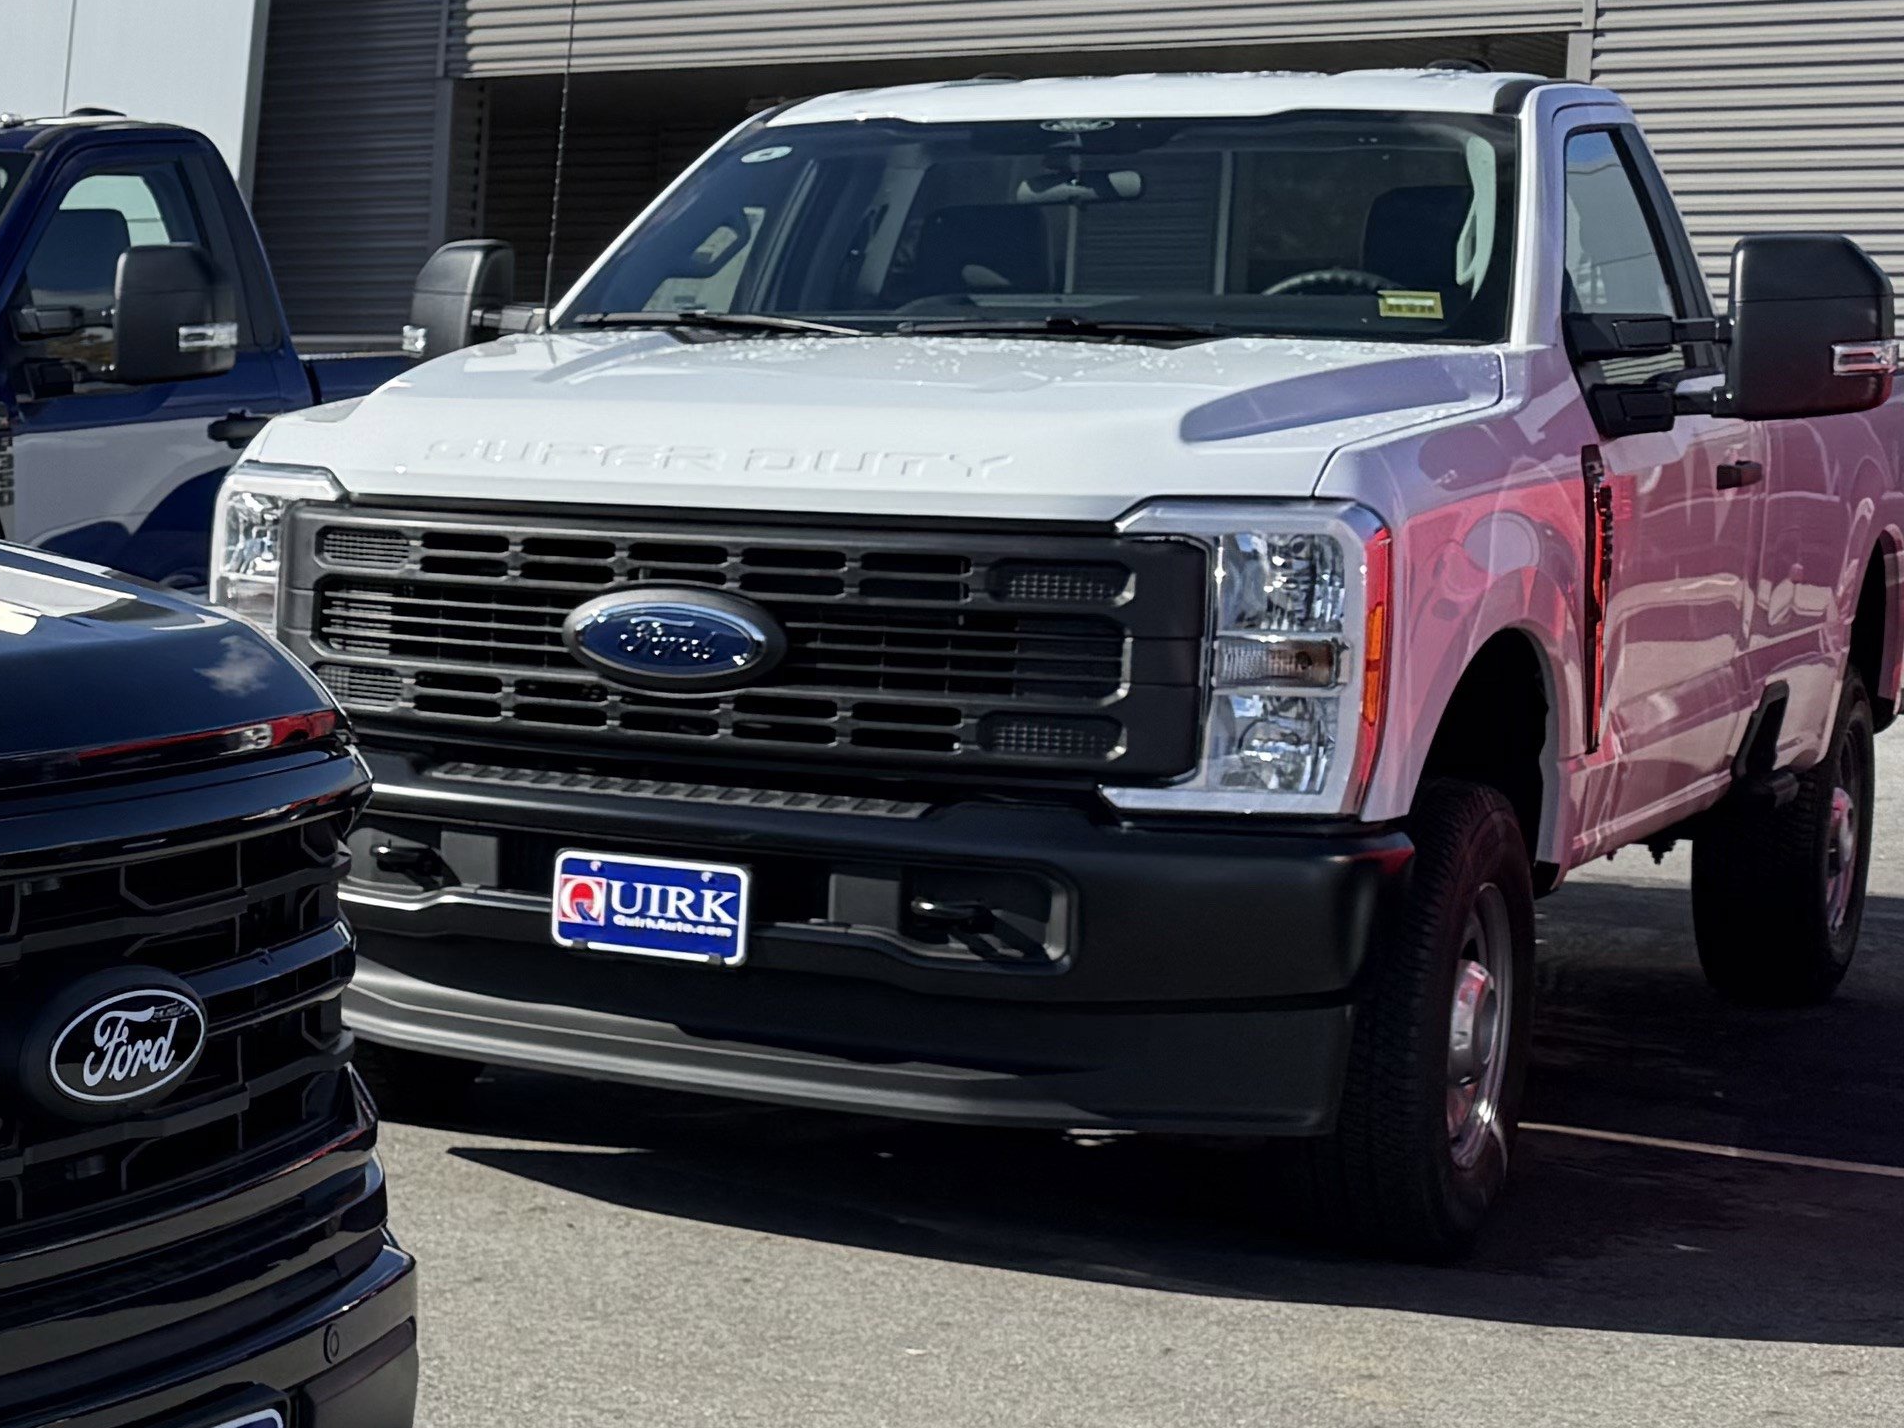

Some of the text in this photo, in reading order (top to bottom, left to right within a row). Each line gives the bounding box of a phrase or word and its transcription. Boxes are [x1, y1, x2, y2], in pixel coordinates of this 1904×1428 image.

[424, 438, 1014, 478] SUPER DUTY
[560, 877, 738, 925] QUIRK
[83, 1006, 179, 1087] Ford
